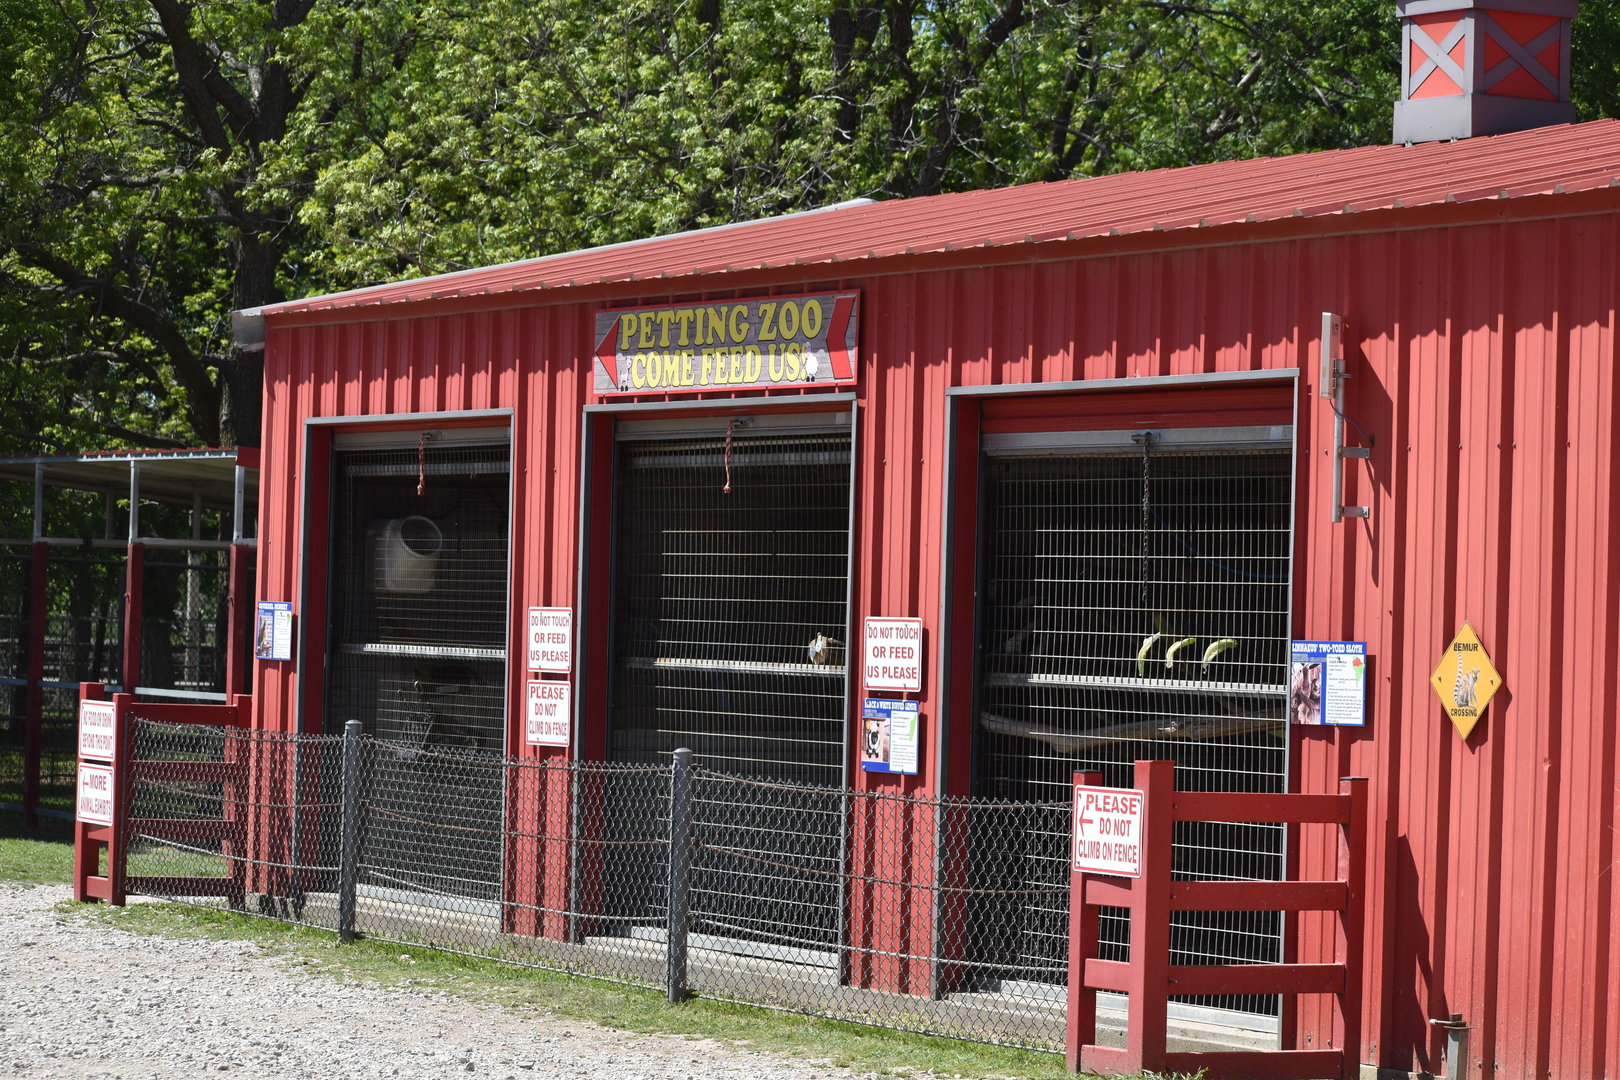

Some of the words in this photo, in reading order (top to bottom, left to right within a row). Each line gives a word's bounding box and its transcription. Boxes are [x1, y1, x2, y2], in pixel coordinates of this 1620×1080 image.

[620, 304, 750, 350] PETTING
[758, 299, 823, 342] ZOO
[631, 349, 695, 389] COME
[699, 344, 762, 386] FEED
[531, 616, 538, 626] DO
[540, 616, 550, 626] NOT
[552, 616, 569, 627] TOUCH
[534, 632, 545, 644] OR
[548, 633, 566, 644] FEED
[868, 627, 878, 638] DO
[880, 627, 894, 639] NOT
[895, 628, 918, 640] TOUCH
[872, 646, 886, 658] OR
[889, 646, 914, 659] FEED
[1319, 644, 1346, 653] TWO-TOED
[1346, 644, 1363, 654] SLOTH
[1454, 643, 1478, 652] LEMUR
[530, 650, 540, 661] US
[542, 650, 568, 662] PLEASE
[868, 666, 880, 678] US
[882, 666, 917, 680] PLEASE
[530, 686, 564, 700] PLEASE
[535, 703, 543, 716] DO
[545, 704, 556, 717] NOT
[1450, 709, 1478, 717] CROSSING
[83, 711, 88, 726] NO
[88, 712, 96, 726] FOOD
[97, 712, 102, 727] OR
[102, 712, 112, 728] DRINK
[529, 720, 543, 735] CLIMB
[545, 721, 552, 736] ON
[553, 722, 567, 736] FENCE
[83, 733, 94, 748] BEYOND
[103, 735, 112, 750] POINT
[90, 774, 106, 791] MORE
[80, 796, 94, 814] ANIMAL
[95, 798, 111, 816] EXHIBITS
[1086, 794, 1137, 815] PLEASE
[1100, 818, 1112, 835] DO
[1114, 818, 1132, 837] NOT
[1078, 840, 1100, 860] CLIMB
[1102, 842, 1112, 860] ON
[1114, 843, 1137, 864] FENCE
